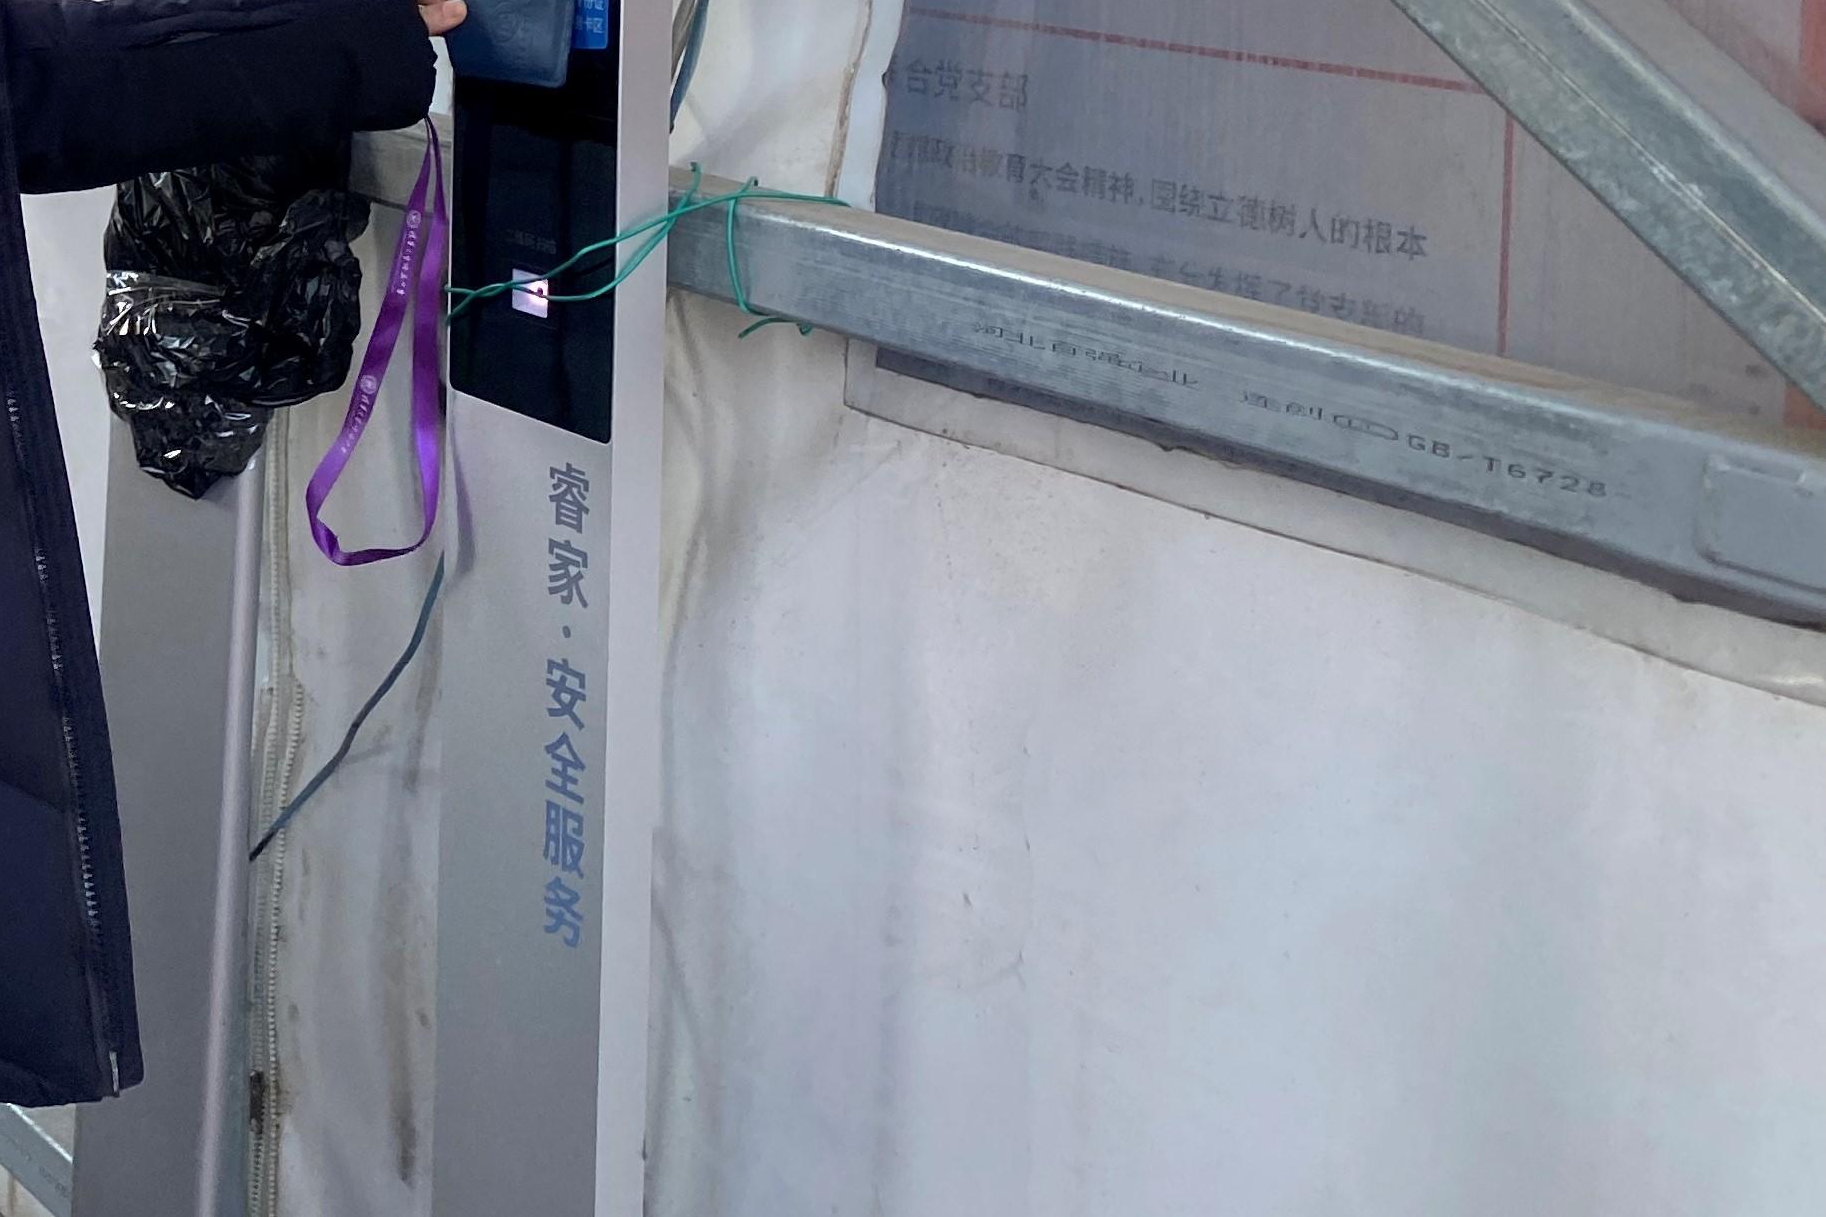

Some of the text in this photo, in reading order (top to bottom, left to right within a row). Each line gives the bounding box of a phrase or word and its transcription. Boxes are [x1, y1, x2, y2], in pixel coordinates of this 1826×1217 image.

[889, 54, 1028, 111] 台党支部
[542, 462, 591, 949] 睿家·安全服务
